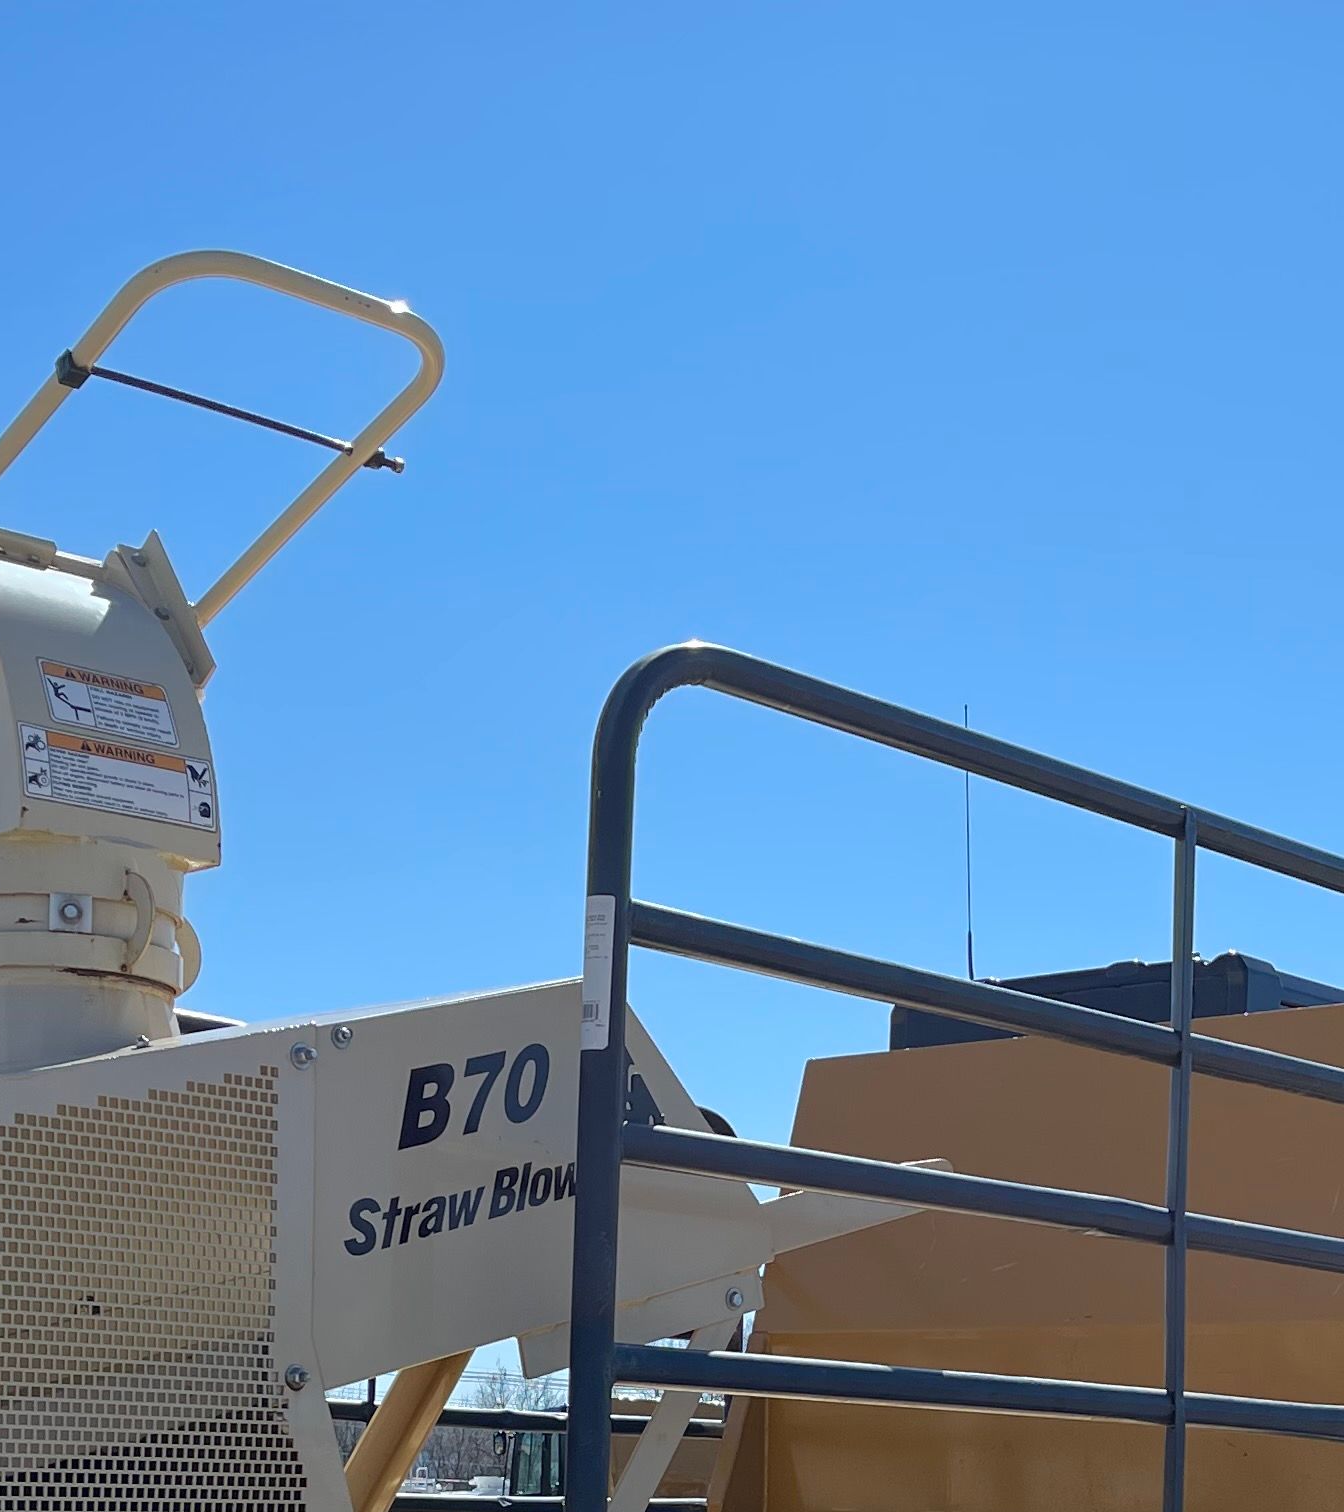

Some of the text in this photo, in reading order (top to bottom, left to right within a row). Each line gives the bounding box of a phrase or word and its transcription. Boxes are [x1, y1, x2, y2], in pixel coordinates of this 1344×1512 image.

[77, 670, 144, 695] WARNING
[93, 742, 156, 765] WARNING
[398, 1043, 550, 1150] B70
[344, 1162, 577, 1256] Straw Blow
